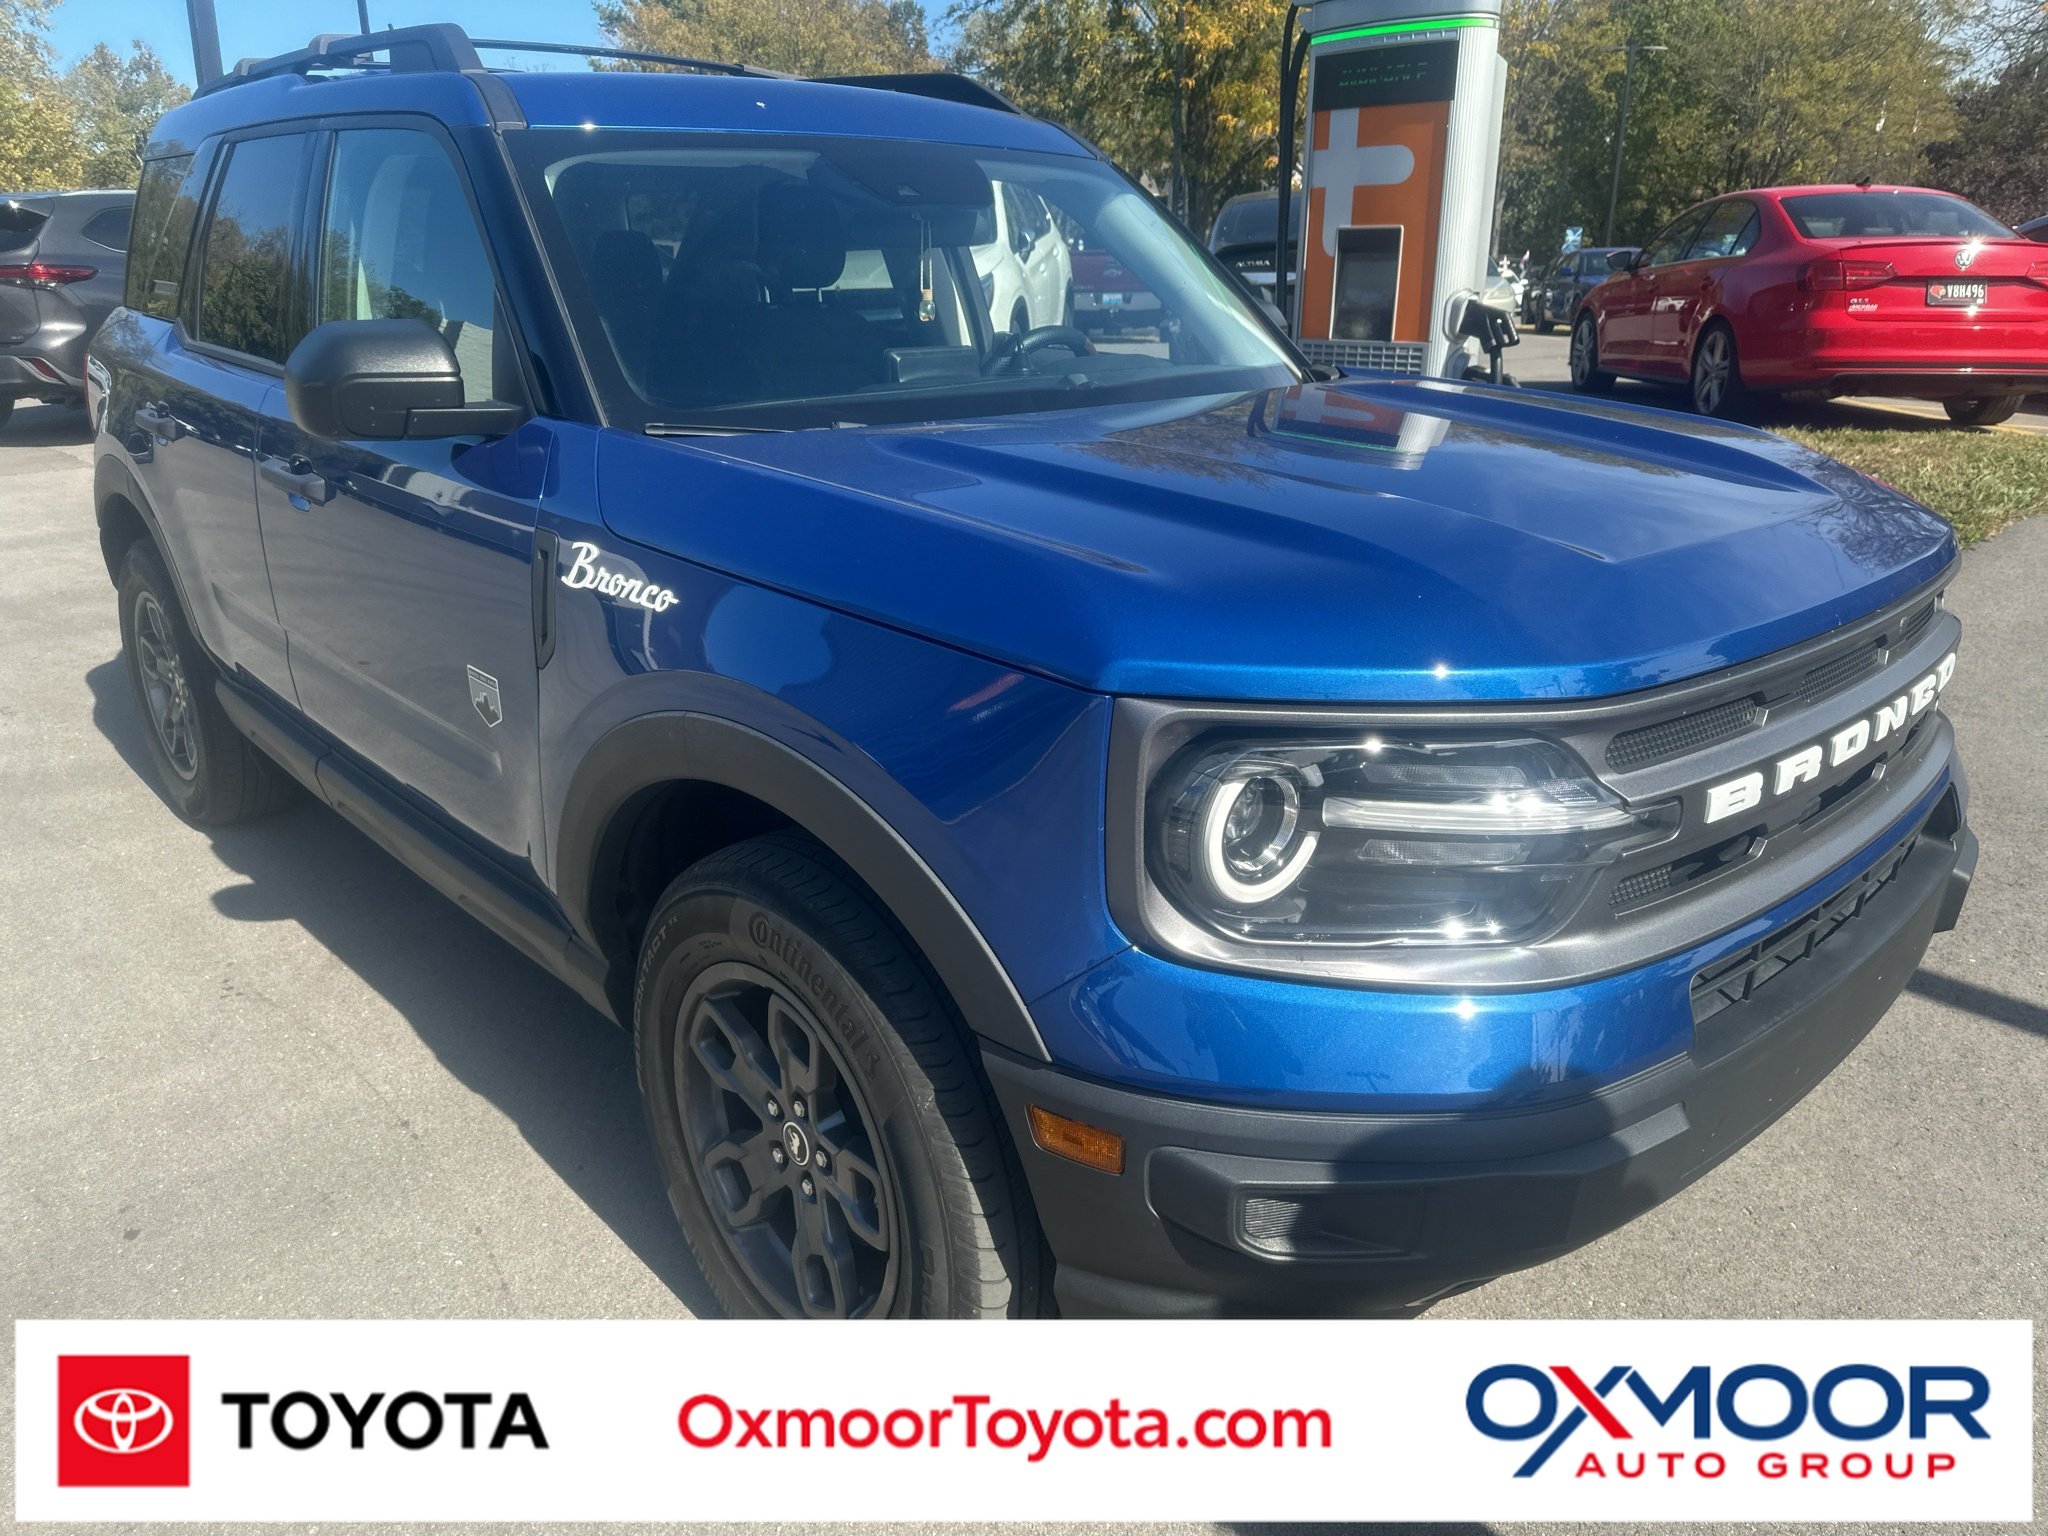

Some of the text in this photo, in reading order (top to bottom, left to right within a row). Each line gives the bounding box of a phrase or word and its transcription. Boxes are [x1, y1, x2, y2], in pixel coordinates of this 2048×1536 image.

[1236, 259, 1271, 268] ALTIMA
[1947, 284, 1984, 298] V8H496
[560, 541, 679, 612] Bronco
[1705, 651, 1956, 824] BRONCO
[748, 911, 870, 1055] Continental
